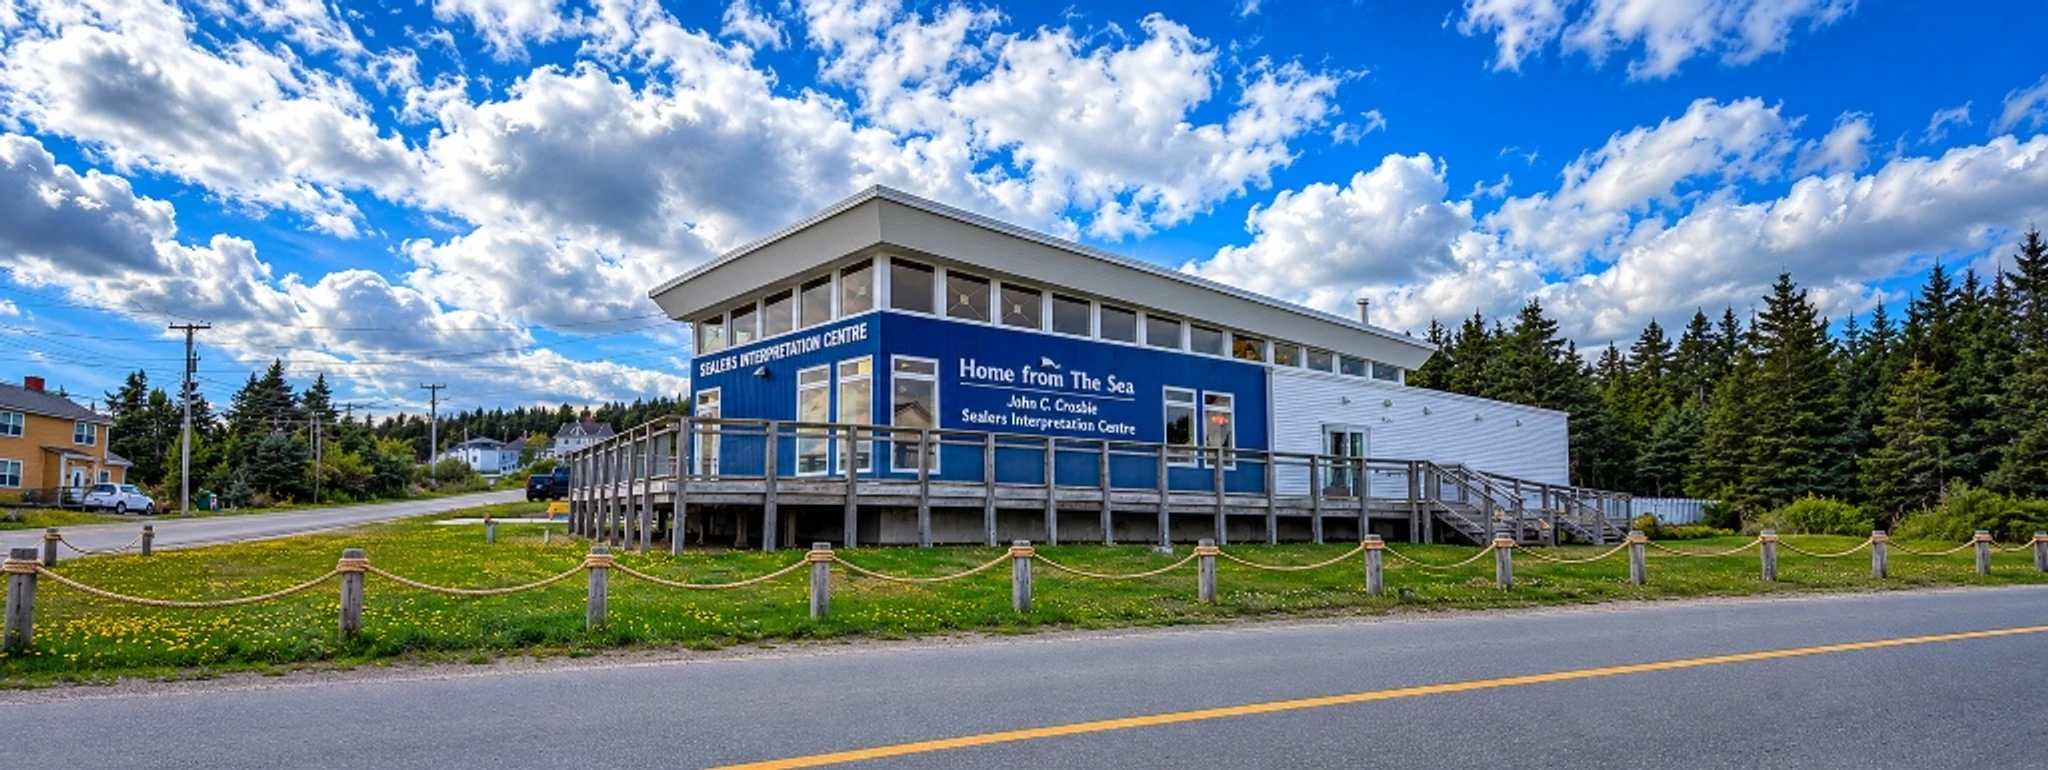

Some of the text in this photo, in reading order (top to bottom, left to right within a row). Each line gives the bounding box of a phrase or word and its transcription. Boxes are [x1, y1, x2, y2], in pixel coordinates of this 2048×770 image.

[700, 323, 867, 377] SEALERS INTERPRETATION CENTRE
[960, 358, 1135, 395] Home from The Sea
[1007, 394, 1098, 415] John C. Crosbie
[961, 408, 1136, 435] Sealers Interpretation Centre
